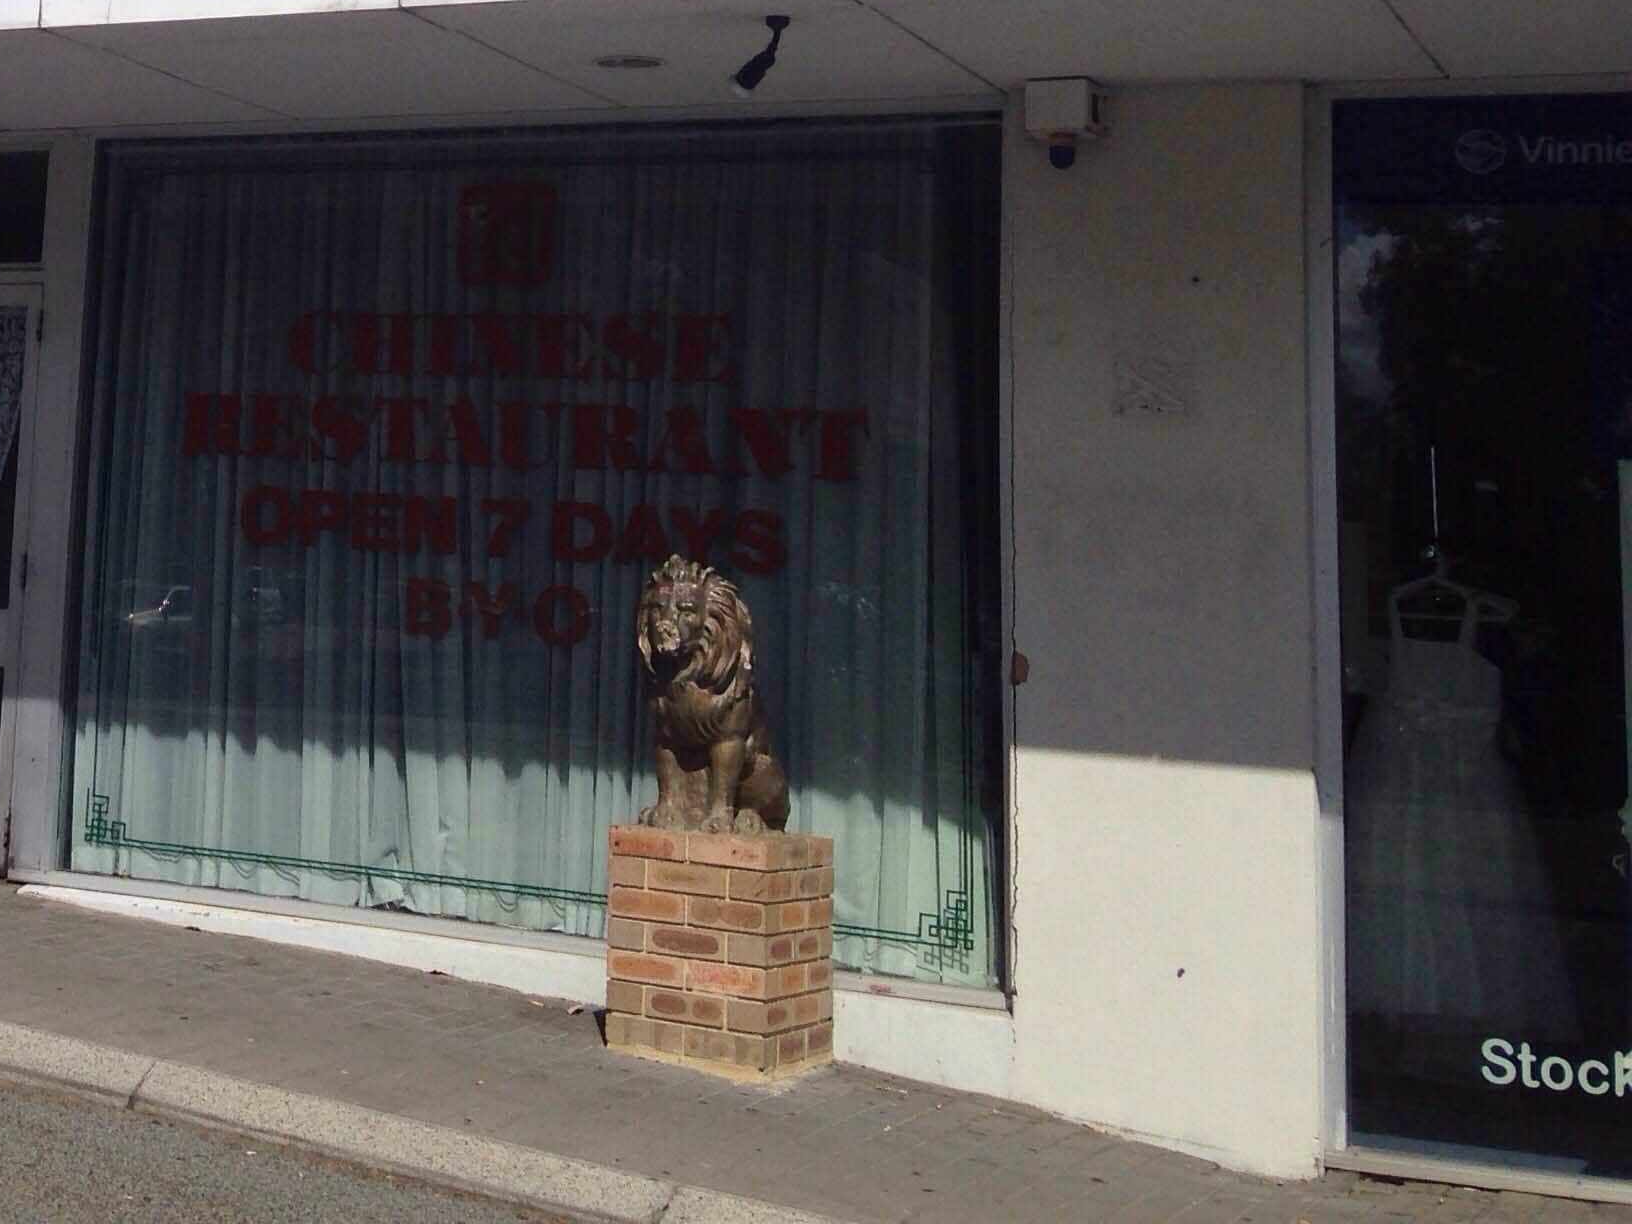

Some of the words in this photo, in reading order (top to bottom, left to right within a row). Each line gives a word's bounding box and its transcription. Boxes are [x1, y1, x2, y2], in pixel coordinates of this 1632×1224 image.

[288, 311, 737, 382] CHINESE
[181, 390, 868, 481] RESTAURANT
[240, 486, 458, 554] OPEN
[479, 498, 530, 558] 7
[549, 500, 788, 575] DAYS
